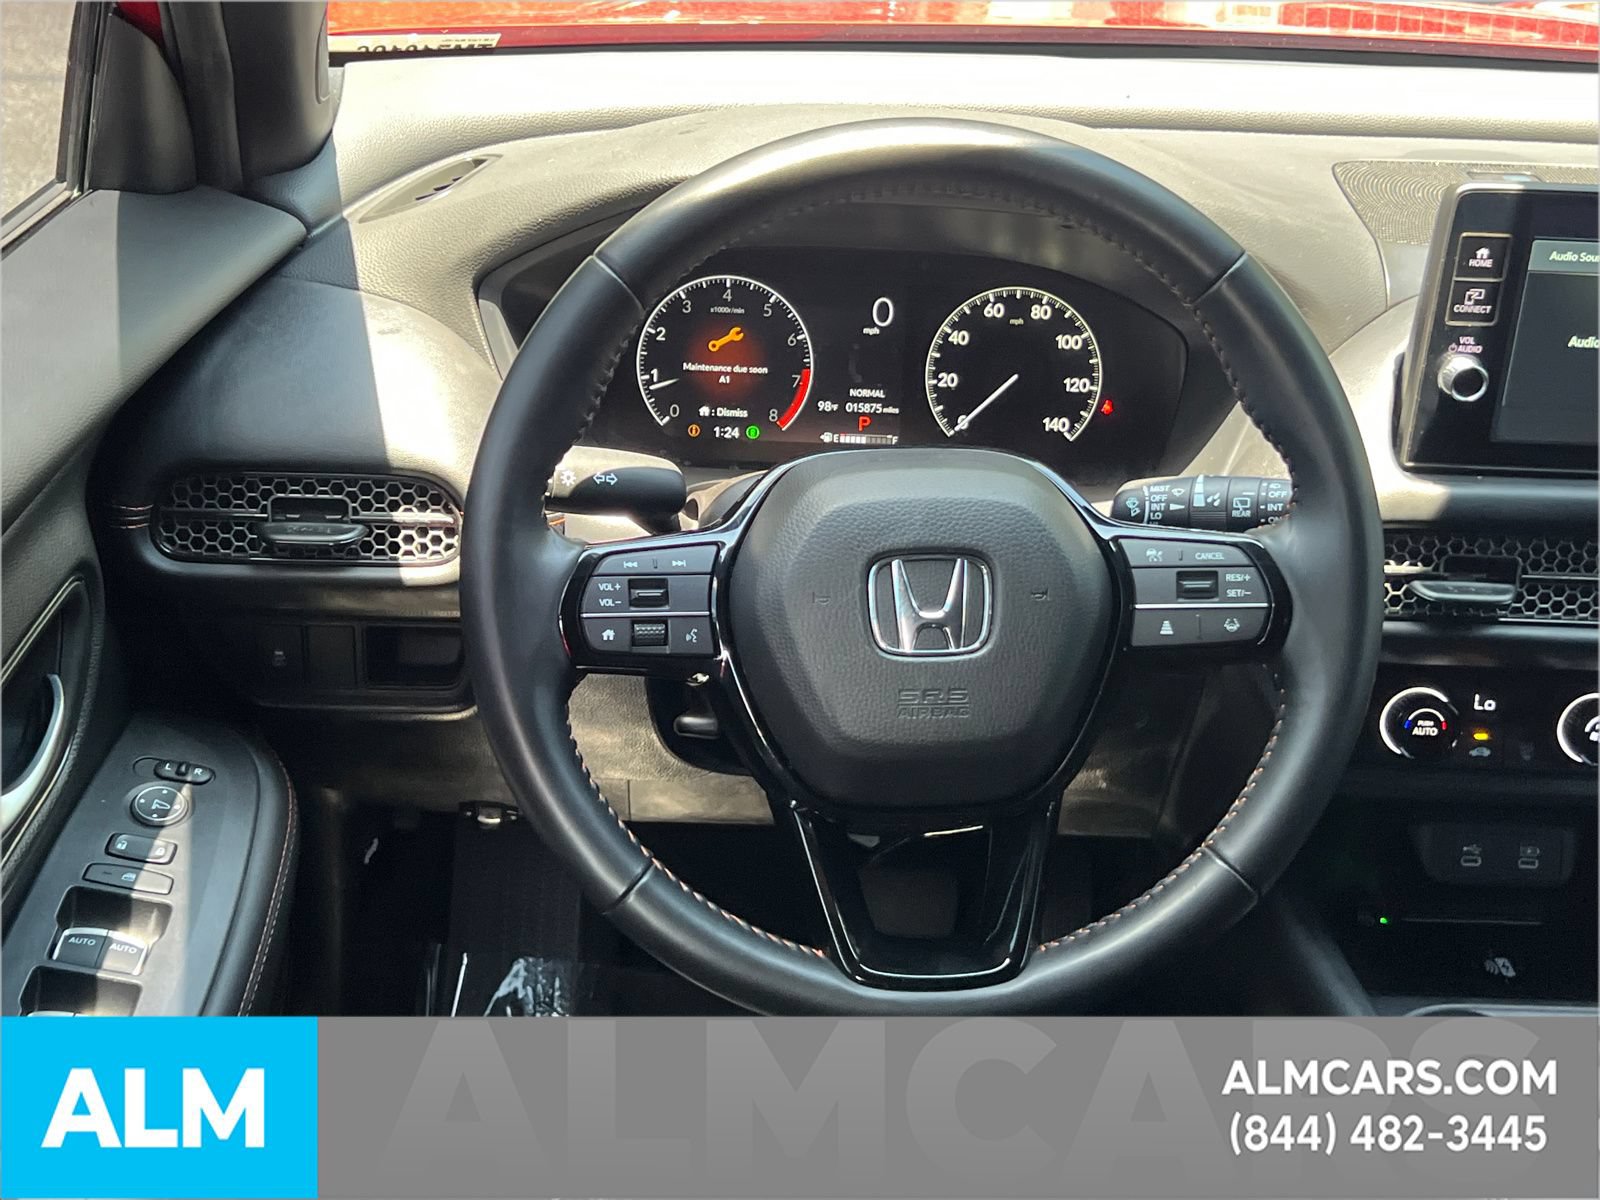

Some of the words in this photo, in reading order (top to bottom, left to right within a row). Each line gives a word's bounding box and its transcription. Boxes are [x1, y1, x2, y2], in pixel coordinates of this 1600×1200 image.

[1549, 250, 1578, 262] Audio
[1468, 259, 1492, 268] HOME
[723, 289, 732, 302] 4
[682, 300, 692, 313] 3
[763, 304, 772, 317] 5
[872, 296, 894, 326] 0
[984, 303, 1005, 318] 60
[1030, 305, 1051, 320] 80
[1454, 304, 1492, 314] CONNECT
[656, 327, 666, 341] 2
[863, 327, 880, 336] mph
[788, 334, 796, 346] 6
[948, 330, 970, 346] 40
[1056, 335, 1082, 350] 100
[1459, 336, 1475, 344] VOL
[1458, 344, 1482, 354] AUDIO
[682, 362, 731, 372] Maintenance
[733, 365, 747, 374] due
[651, 369, 658, 382] 1
[792, 375, 800, 388] 7
[937, 372, 958, 388] 20
[1064, 378, 1090, 393] 120
[850, 388, 886, 398] NORMAL
[670, 404, 680, 417] 0
[717, 408, 748, 418] Dismiss
[846, 402, 882, 414] 015875
[769, 408, 778, 422] 8
[858, 416, 872, 432] P
[1042, 417, 1070, 432] 140
[714, 426, 740, 438] 1:24
[834, 434, 840, 442] E
[892, 436, 899, 445] F
[1150, 494, 1168, 502] OFF
[1151, 503, 1166, 511] INT
[1268, 504, 1284, 512] INT
[898, 688, 968, 703] SRS
[1474, 694, 1496, 710] Lo
[897, 707, 970, 719] AIRBAG
[1412, 727, 1438, 736] AUTO
[164, 762, 171, 770] L
[194, 768, 202, 776] R
[68, 936, 96, 946] AUTO
[110, 942, 137, 954] AUTO
